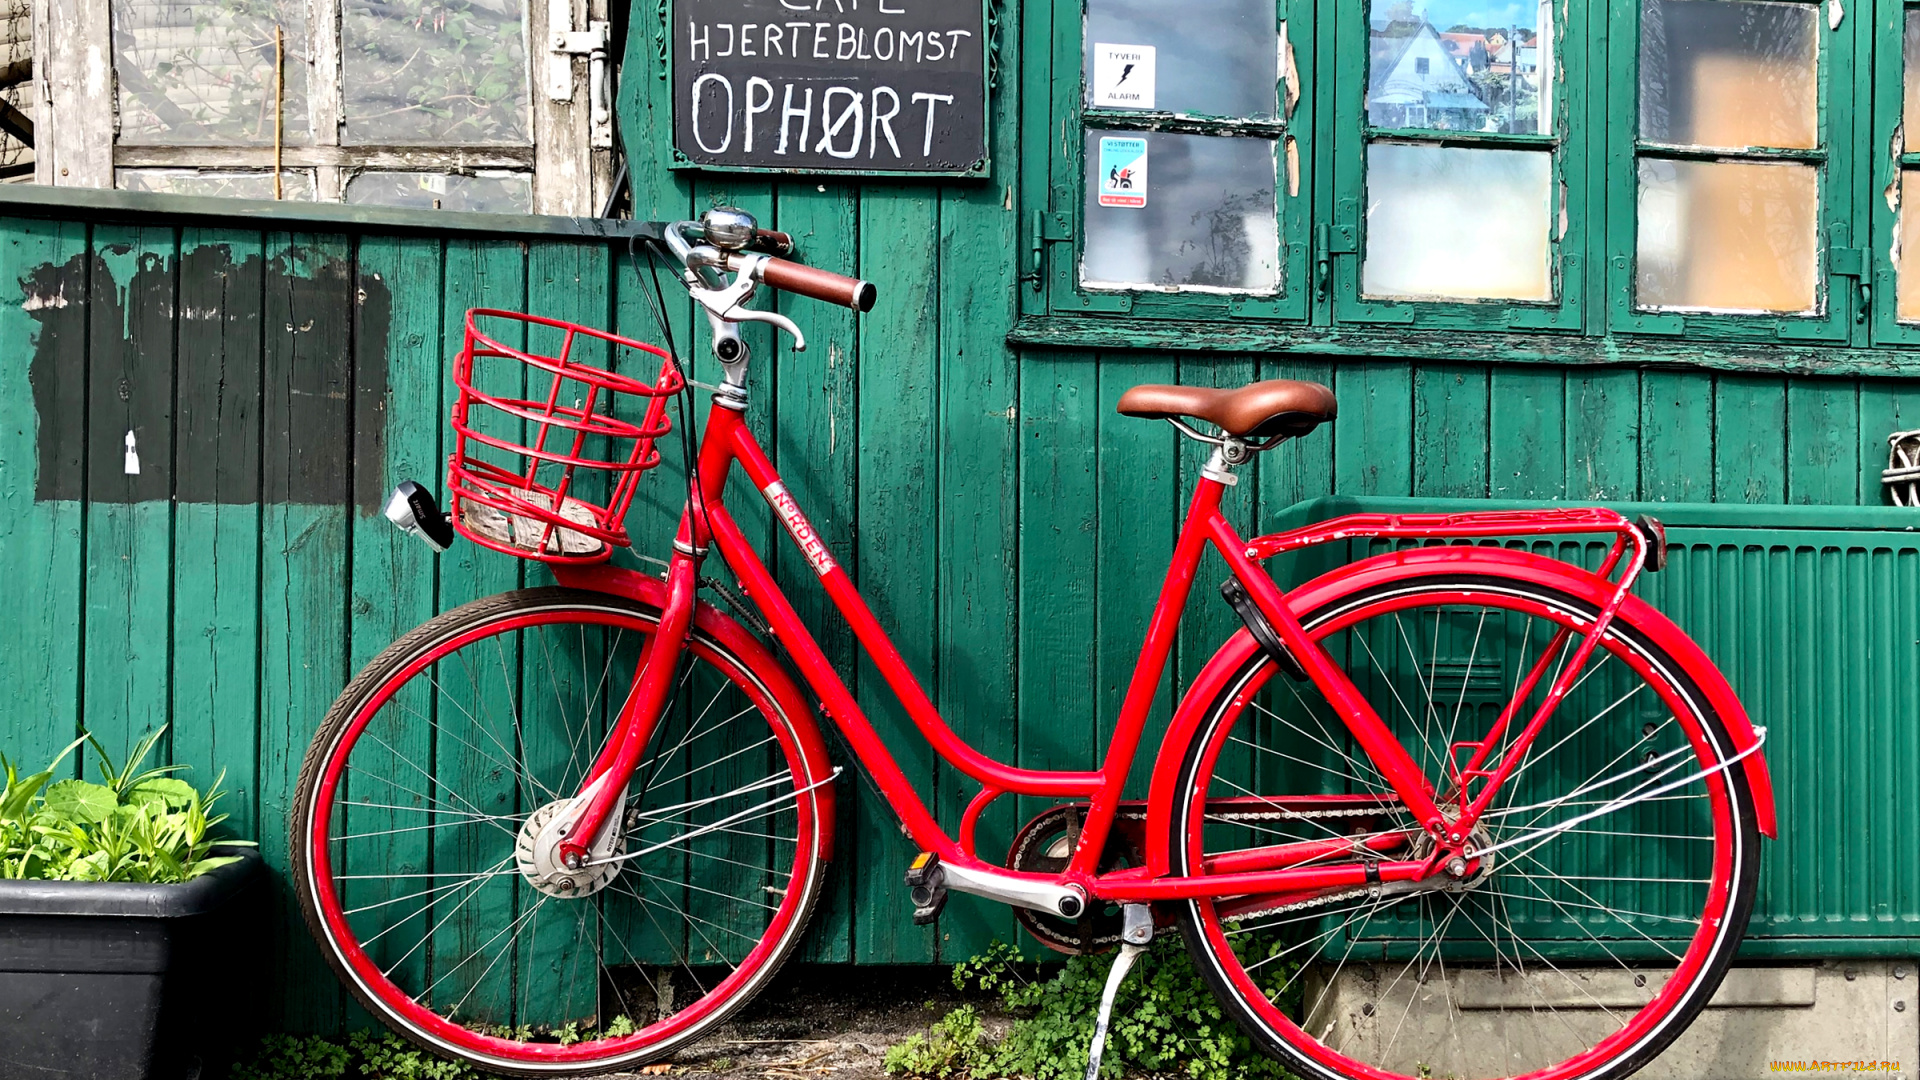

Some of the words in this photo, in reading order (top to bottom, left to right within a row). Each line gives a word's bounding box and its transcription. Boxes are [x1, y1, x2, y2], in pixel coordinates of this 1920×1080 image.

[690, 22, 971, 62] HJERTEBLOMST
[1109, 52, 1141, 60] TYVERI
[1108, 92, 1140, 100] ALARM
[692, 74, 953, 158] OPHØRT
